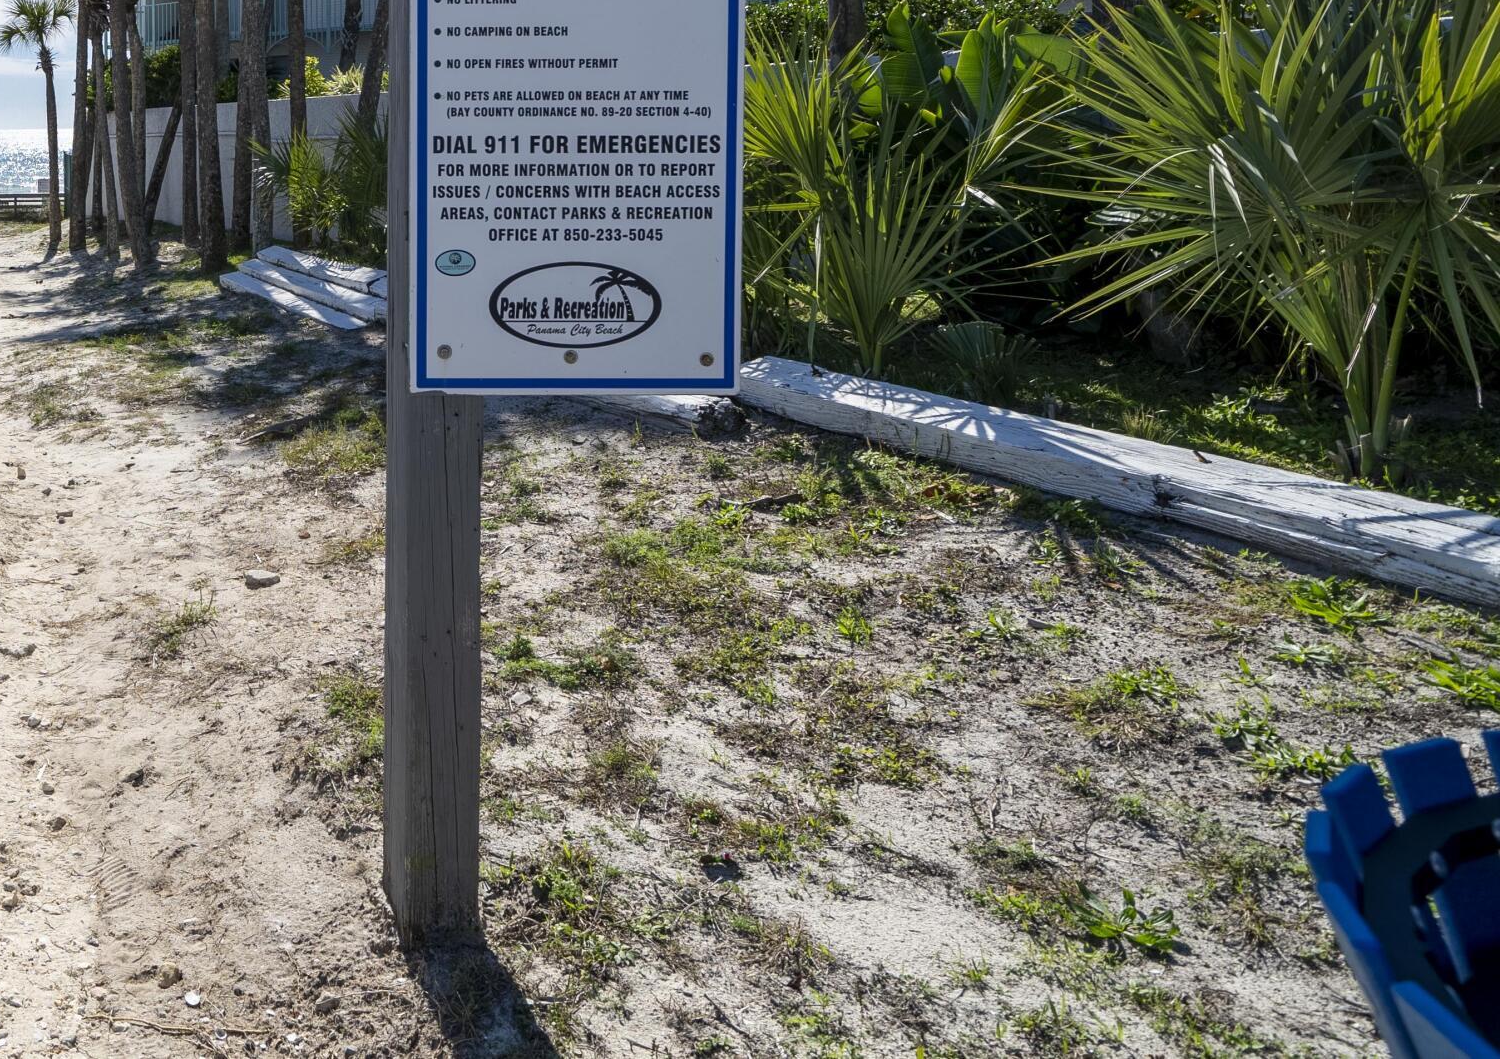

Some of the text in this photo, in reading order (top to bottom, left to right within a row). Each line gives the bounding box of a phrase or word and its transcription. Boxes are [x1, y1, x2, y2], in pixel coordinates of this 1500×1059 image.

[447, 26, 568, 36] NO CAMPING ON BEACH
[447, 106, 711, 118] (BAY COUNTY ORDINANCE NO. 89-20 SECTION 4-40)
[433, 134, 720, 153] DIAL 911 FOR EMERGENCIES
[438, 163, 715, 176] FOR MORE INFORMATION OR TO REPORT
[489, 228, 663, 241] OFFICE AT 850-233-5045
[500, 297, 537, 319] Parks
[554, 297, 625, 319] Recreation
[527, 324, 623, 336] Panama City Beach
